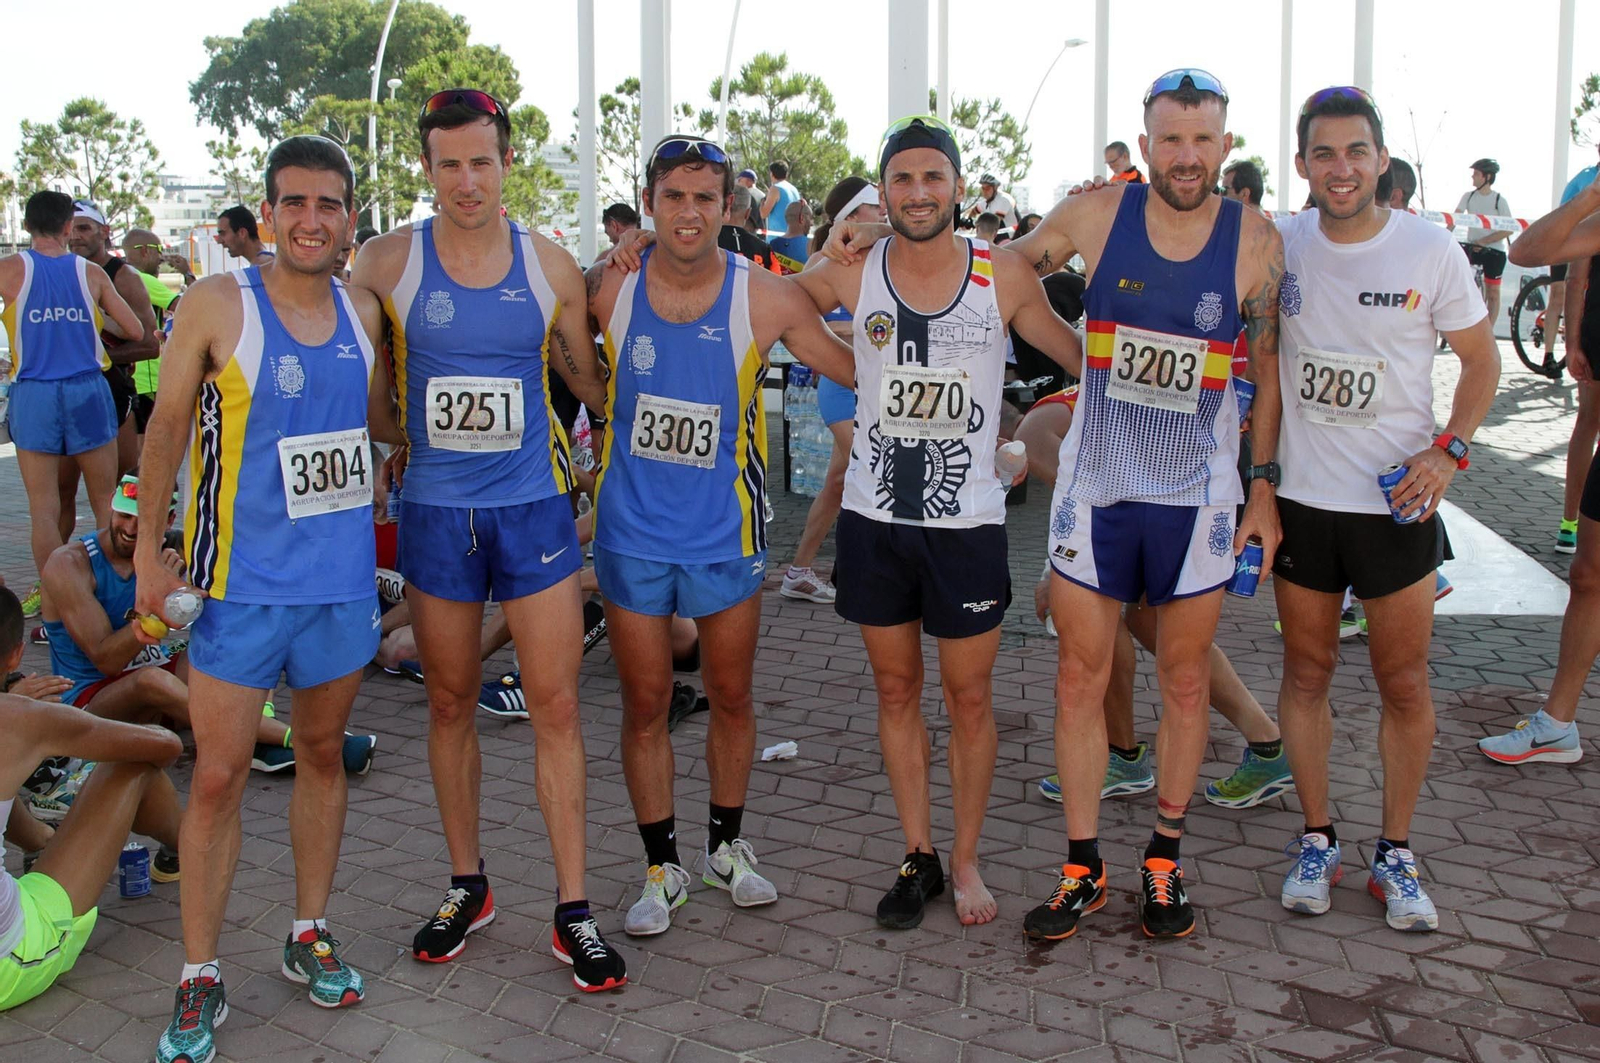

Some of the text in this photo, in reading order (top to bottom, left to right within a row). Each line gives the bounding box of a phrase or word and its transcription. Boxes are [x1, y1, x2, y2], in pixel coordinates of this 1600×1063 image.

[1359, 292, 1408, 307] CNP
[29, 308, 89, 323] CAPOL
[1117, 342, 1196, 392] 3203
[1300, 362, 1376, 409] 3289
[887, 379, 964, 420] 3270
[1156, 390, 1197, 402] DEPORTIVA
[434, 391, 510, 431] 3251
[1336, 409, 1377, 419] DEPORTIVA
[638, 411, 713, 457] 3303
[929, 421, 966, 429] DEPORTIVA
[481, 433, 520, 441] DEPORTIVA
[290, 445, 366, 495] 3304
[676, 456, 713, 466] DEPORTIVA
[927, 443, 943, 492] CIONAL DE
[337, 487, 372, 500] DEPORTIVA
[376, 576, 400, 600] 300
